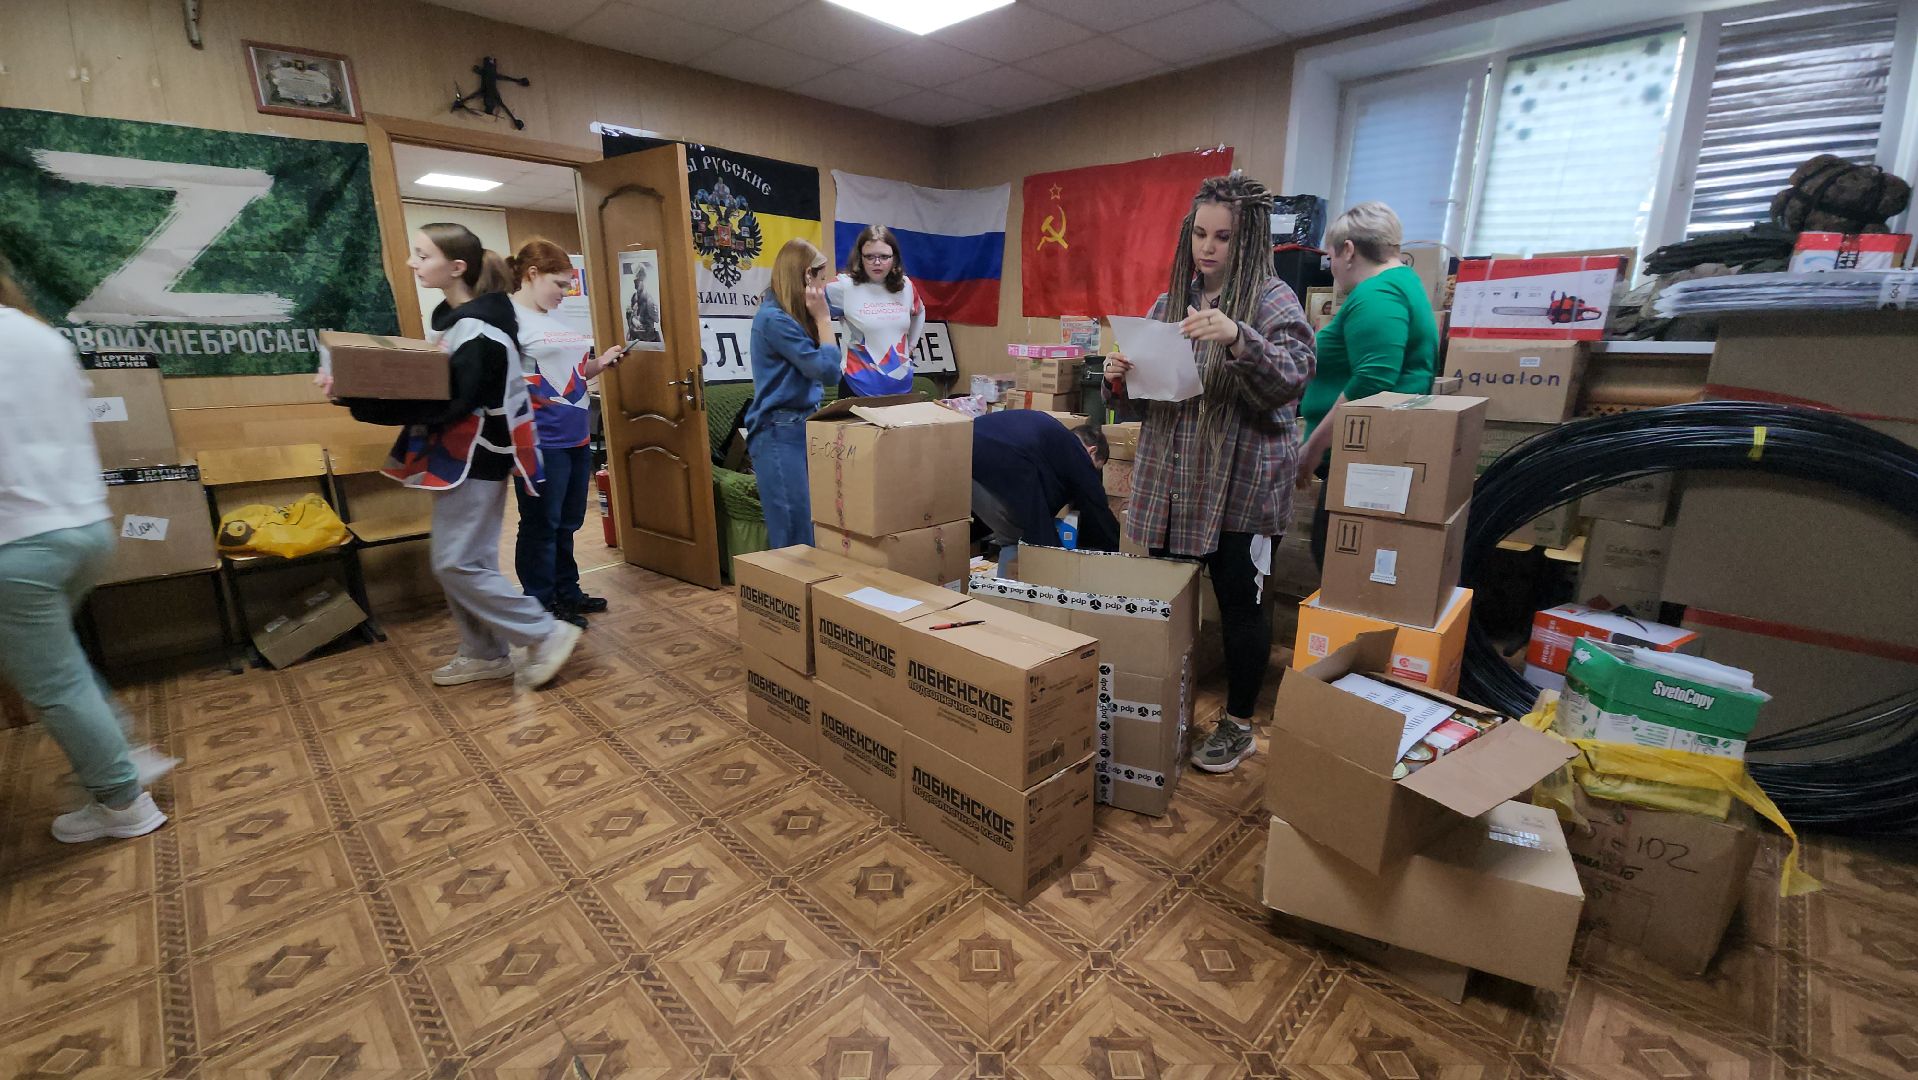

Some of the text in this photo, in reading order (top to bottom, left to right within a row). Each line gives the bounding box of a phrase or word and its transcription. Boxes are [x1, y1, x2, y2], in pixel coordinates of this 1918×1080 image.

[687, 157, 698, 173] Ы
[30, 148, 298, 327] Z
[1453, 368, 1560, 387] Aqualon
[740, 583, 800, 622] ЛОБНЕНСКОЕ
[819, 617, 896, 667] ЛОБНЕНСКОЕ
[747, 669, 811, 715] ЛОБНЕНСКОЕ
[908, 659, 1013, 721] ЛОБНЕНСКОЕ
[908, 679, 977, 718] подсолнечное
[977, 711, 1013, 734] масло
[1652, 680, 1715, 710] SvetoCopy
[821, 711, 898, 769] ЛОБНЕНСКОЕ
[912, 765, 1015, 841] ЛОБНЕНСКОЕ
[980, 824, 1014, 853] масло
[1636, 836, 1701, 874] 102
